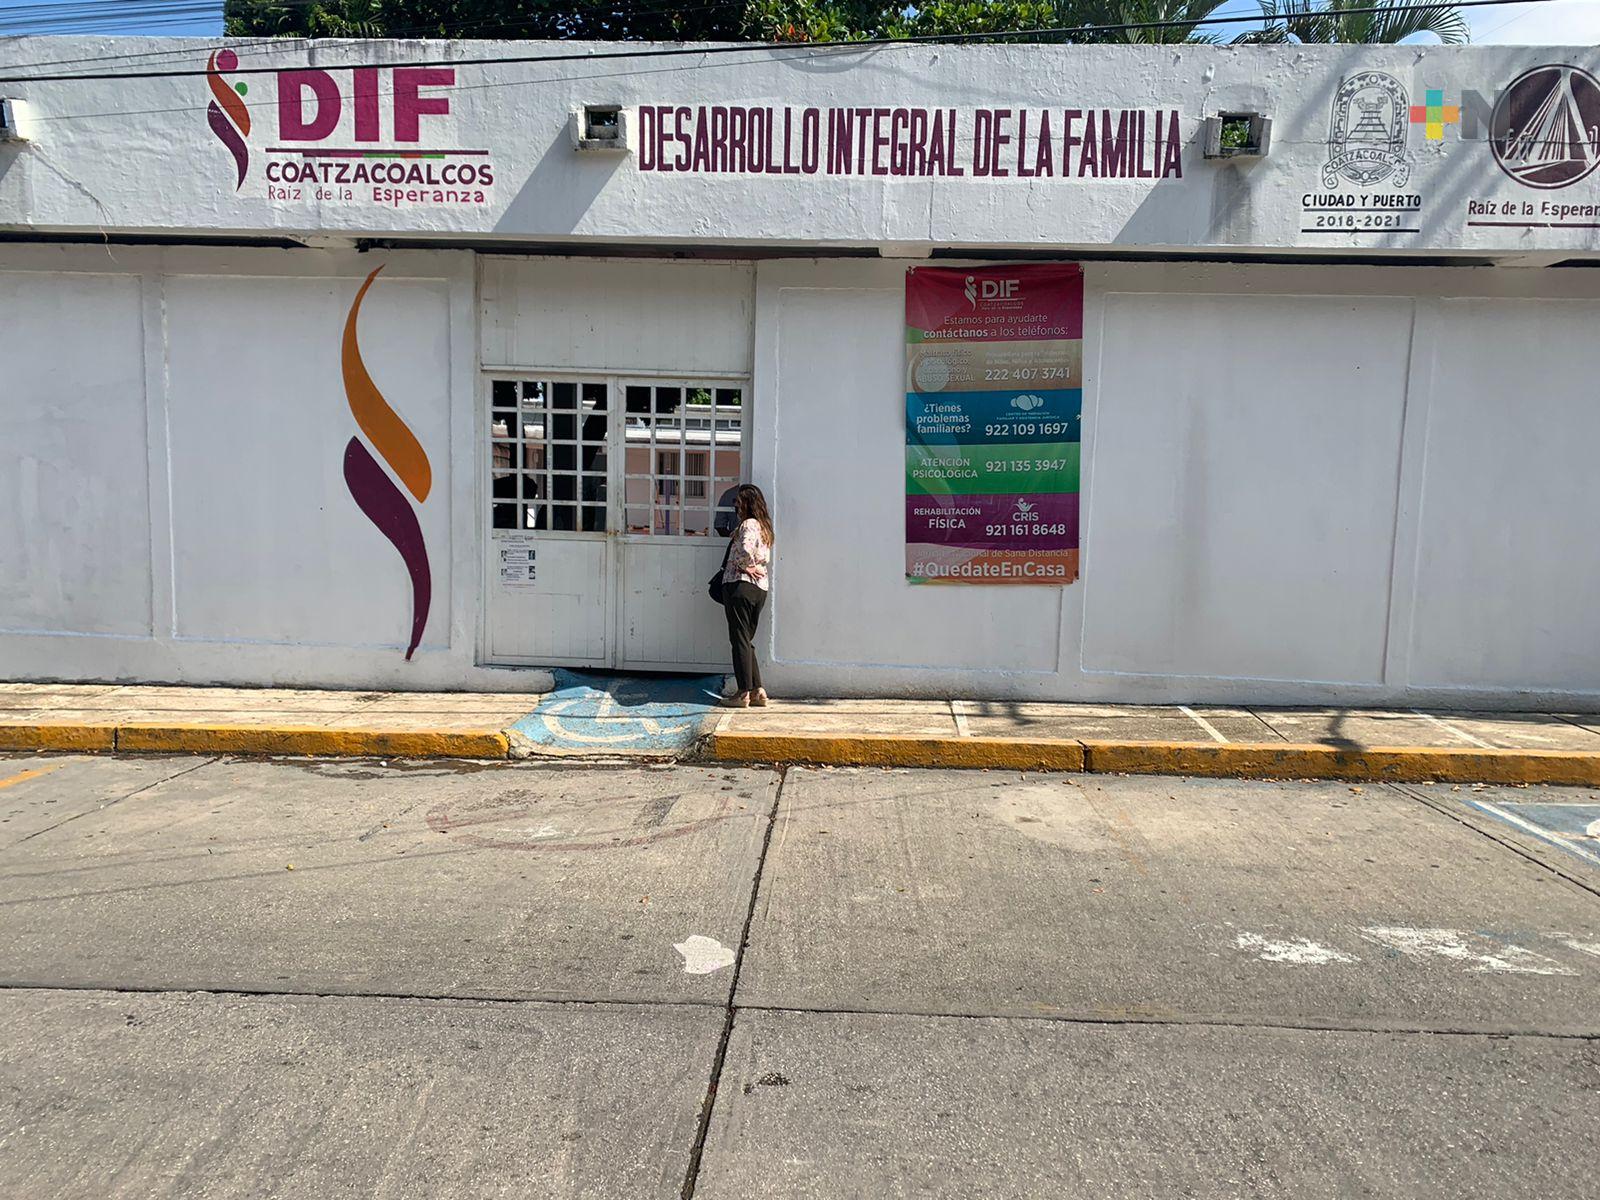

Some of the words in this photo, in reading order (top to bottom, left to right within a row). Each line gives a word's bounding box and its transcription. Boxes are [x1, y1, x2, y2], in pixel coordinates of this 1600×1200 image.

[277, 68, 455, 142] DIF
[638, 105, 819, 174] DESARROLLO
[826, 107, 964, 177] INTEGRAL
[972, 109, 1012, 178] DE
[1018, 109, 1054, 178] LA
[1061, 109, 1183, 179] FAMILIA
[1324, 150, 1406, 174] COATZACOAL
[265, 161, 494, 186] COATZACOALCOS
[315, 187, 332, 200] de
[339, 187, 352, 200] la
[373, 187, 485, 207] Esperanza
[1302, 194, 1355, 207] CIUDAD
[1360, 194, 1369, 207] Y
[1373, 194, 1421, 207] PUERTO
[1468, 200, 1497, 215] Raíz
[1501, 201, 1517, 215] de
[1522, 201, 1534, 215] la
[1316, 215, 1401, 227] 2018-2021
[981, 279, 1020, 299] DIF
[944, 316, 983, 325] Estamos
[985, 316, 1005, 326] para
[1007, 314, 1048, 324] ayudarte
[923, 328, 989, 339] contáctanos
[990, 329, 997, 337] a
[1000, 326, 1015, 337] los
[985, 370, 1009, 381] 222
[1012, 368, 1038, 380] 407
[1041, 367, 1071, 379] 3741
[924, 404, 962, 414] ¿Tienes
[916, 415, 970, 427] problemas
[917, 423, 972, 434] familiares?
[985, 425, 1009, 436] 922
[1013, 424, 1036, 435] 109
[1039, 422, 1069, 434] 1697
[985, 461, 1007, 472] 921
[1011, 461, 1031, 471] 135
[1034, 459, 1067, 471] 3947
[913, 505, 981, 516] REHABILITACIÓN
[1012, 511, 1040, 522] CRIS
[928, 517, 966, 529] FÍSICA
[985, 525, 1007, 536] 921
[1010, 525, 1029, 536] 161
[1032, 524, 1066, 535] 8648
[991, 549, 1003, 557] de
[1005, 549, 1026, 557] Sana
[1028, 548, 1069, 557] Distancia
[913, 561, 1066, 578] #QuedateEnCasa
